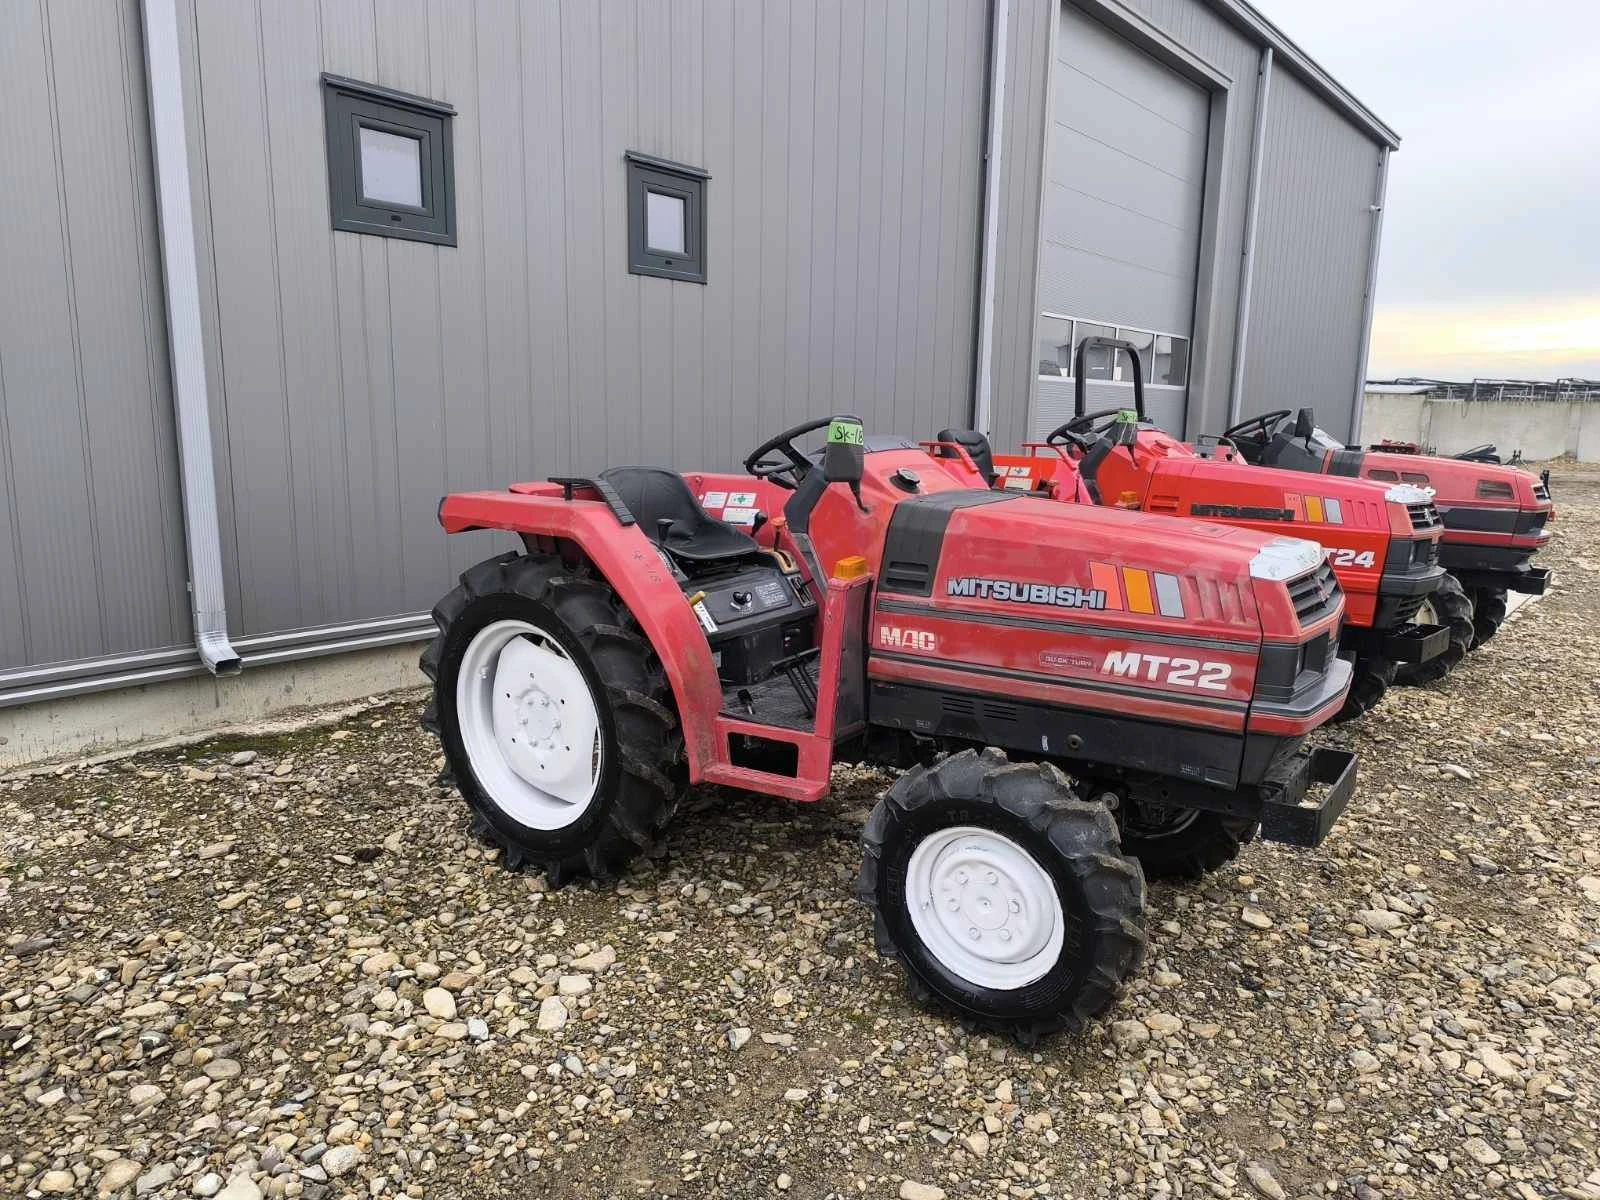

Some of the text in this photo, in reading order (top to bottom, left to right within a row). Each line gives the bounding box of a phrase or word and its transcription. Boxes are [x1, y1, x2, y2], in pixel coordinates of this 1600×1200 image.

[1320, 547, 1376, 568] T24
[947, 577, 1106, 609] MITSUBISHI
[880, 626, 936, 651] MAC
[1101, 651, 1232, 691] MT22
